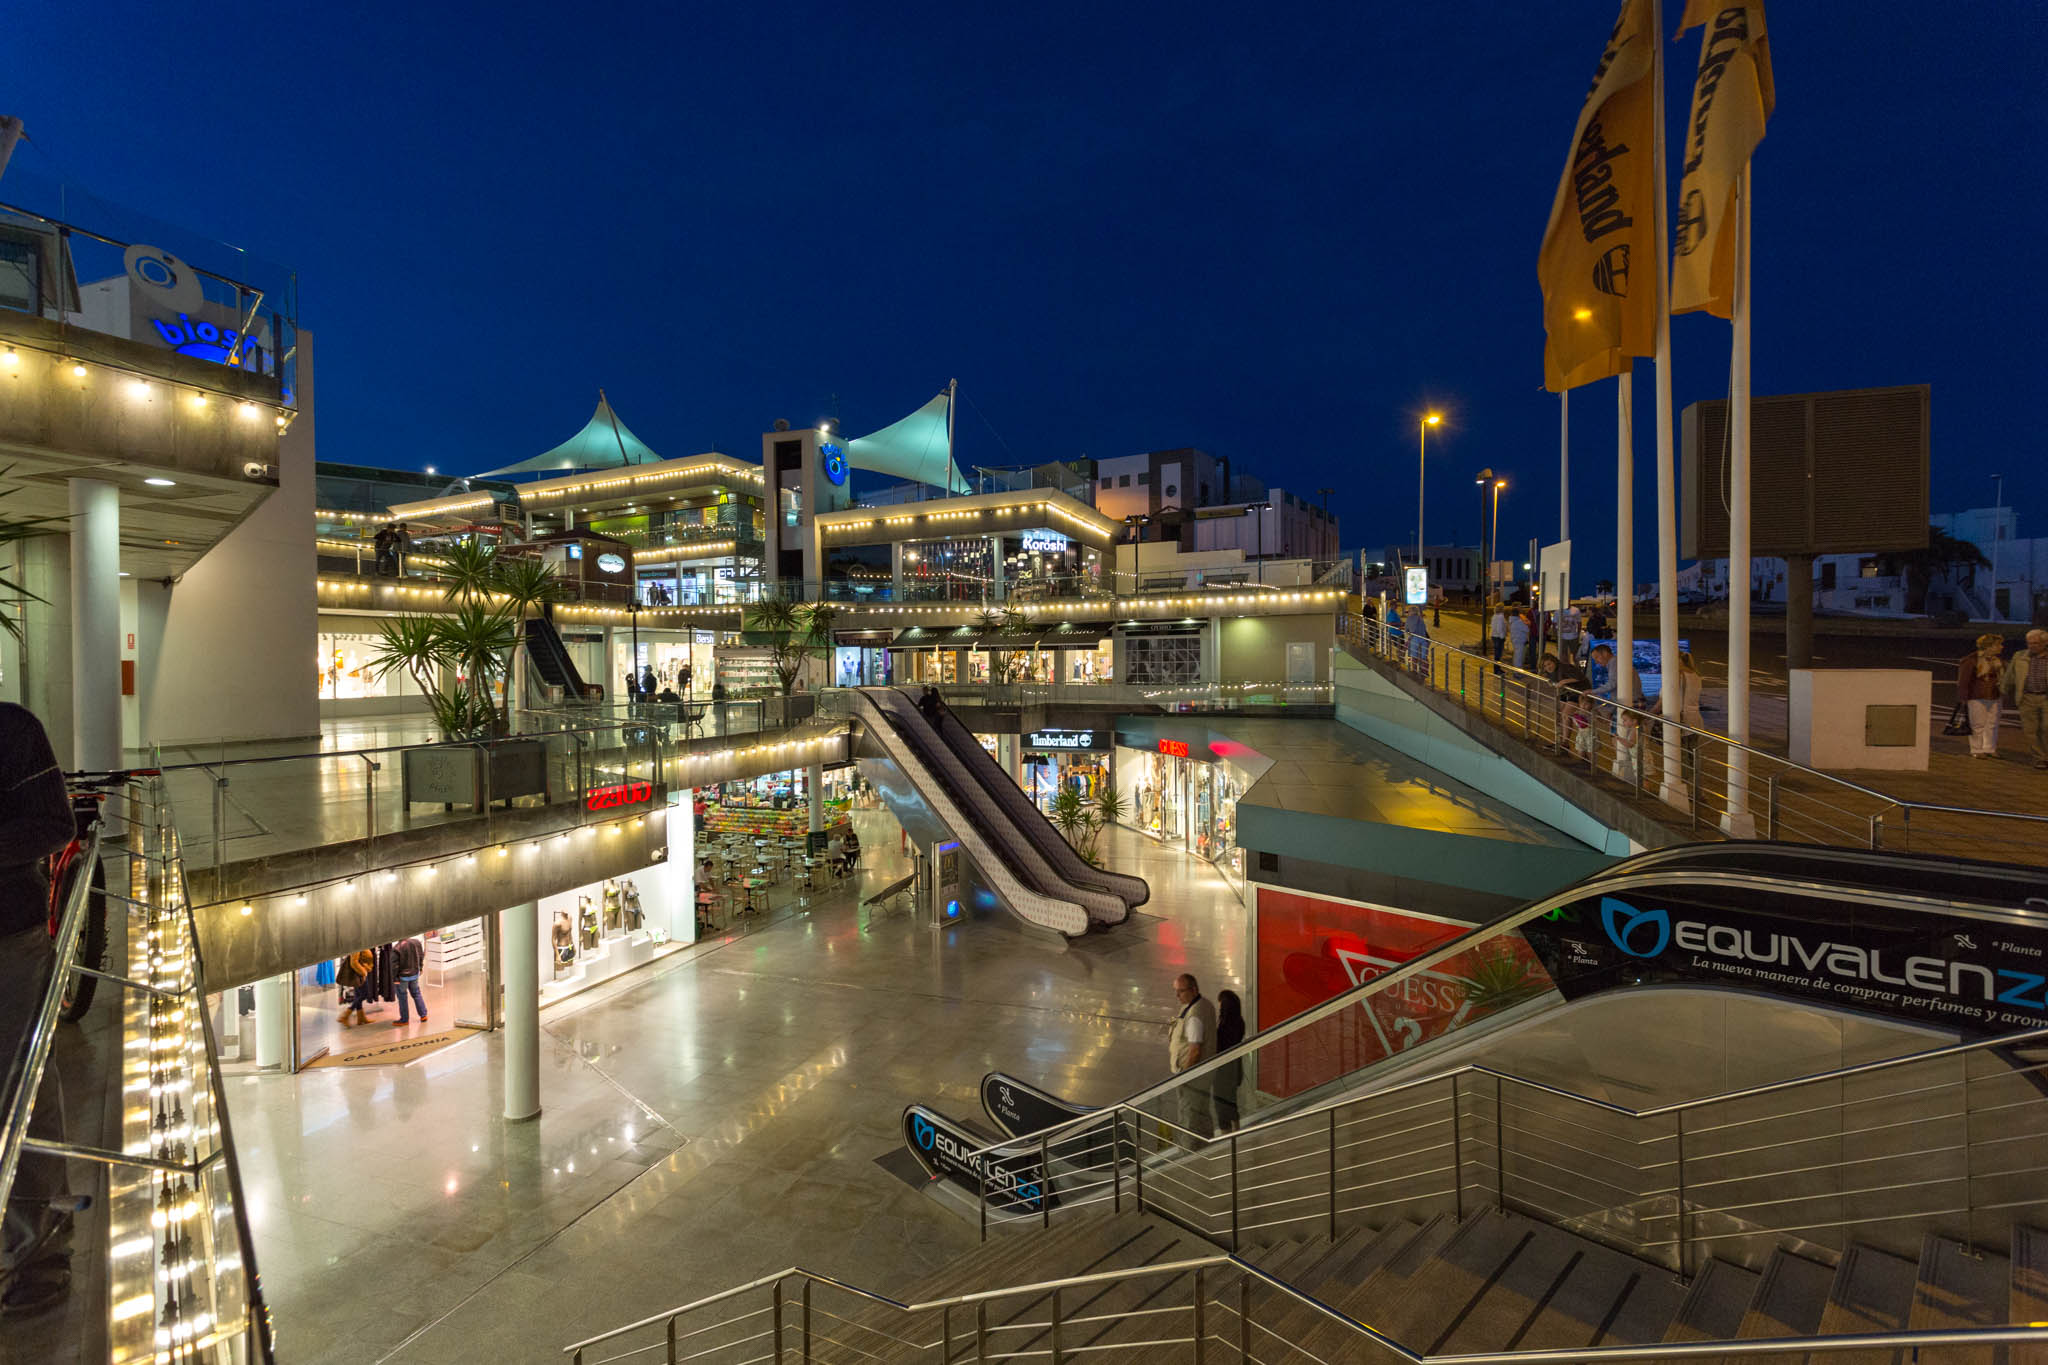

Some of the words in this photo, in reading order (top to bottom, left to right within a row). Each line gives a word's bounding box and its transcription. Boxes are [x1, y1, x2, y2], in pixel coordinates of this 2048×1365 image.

[1030, 733, 1079, 747] Timberland
[2001, 941, 2042, 957] Planta
[1573, 955, 1599, 966] Planta
[1692, 955, 1709, 968] La
[1712, 961, 1752, 976] nueva
[1755, 970, 1809, 986] manera
[1813, 977, 1830, 990] de
[1833, 983, 1899, 1000] comprar
[1901, 993, 1982, 1017] perfumes
[1984, 1009, 1997, 1022] y
[343, 1037, 450, 1062] CALZEDONIA
